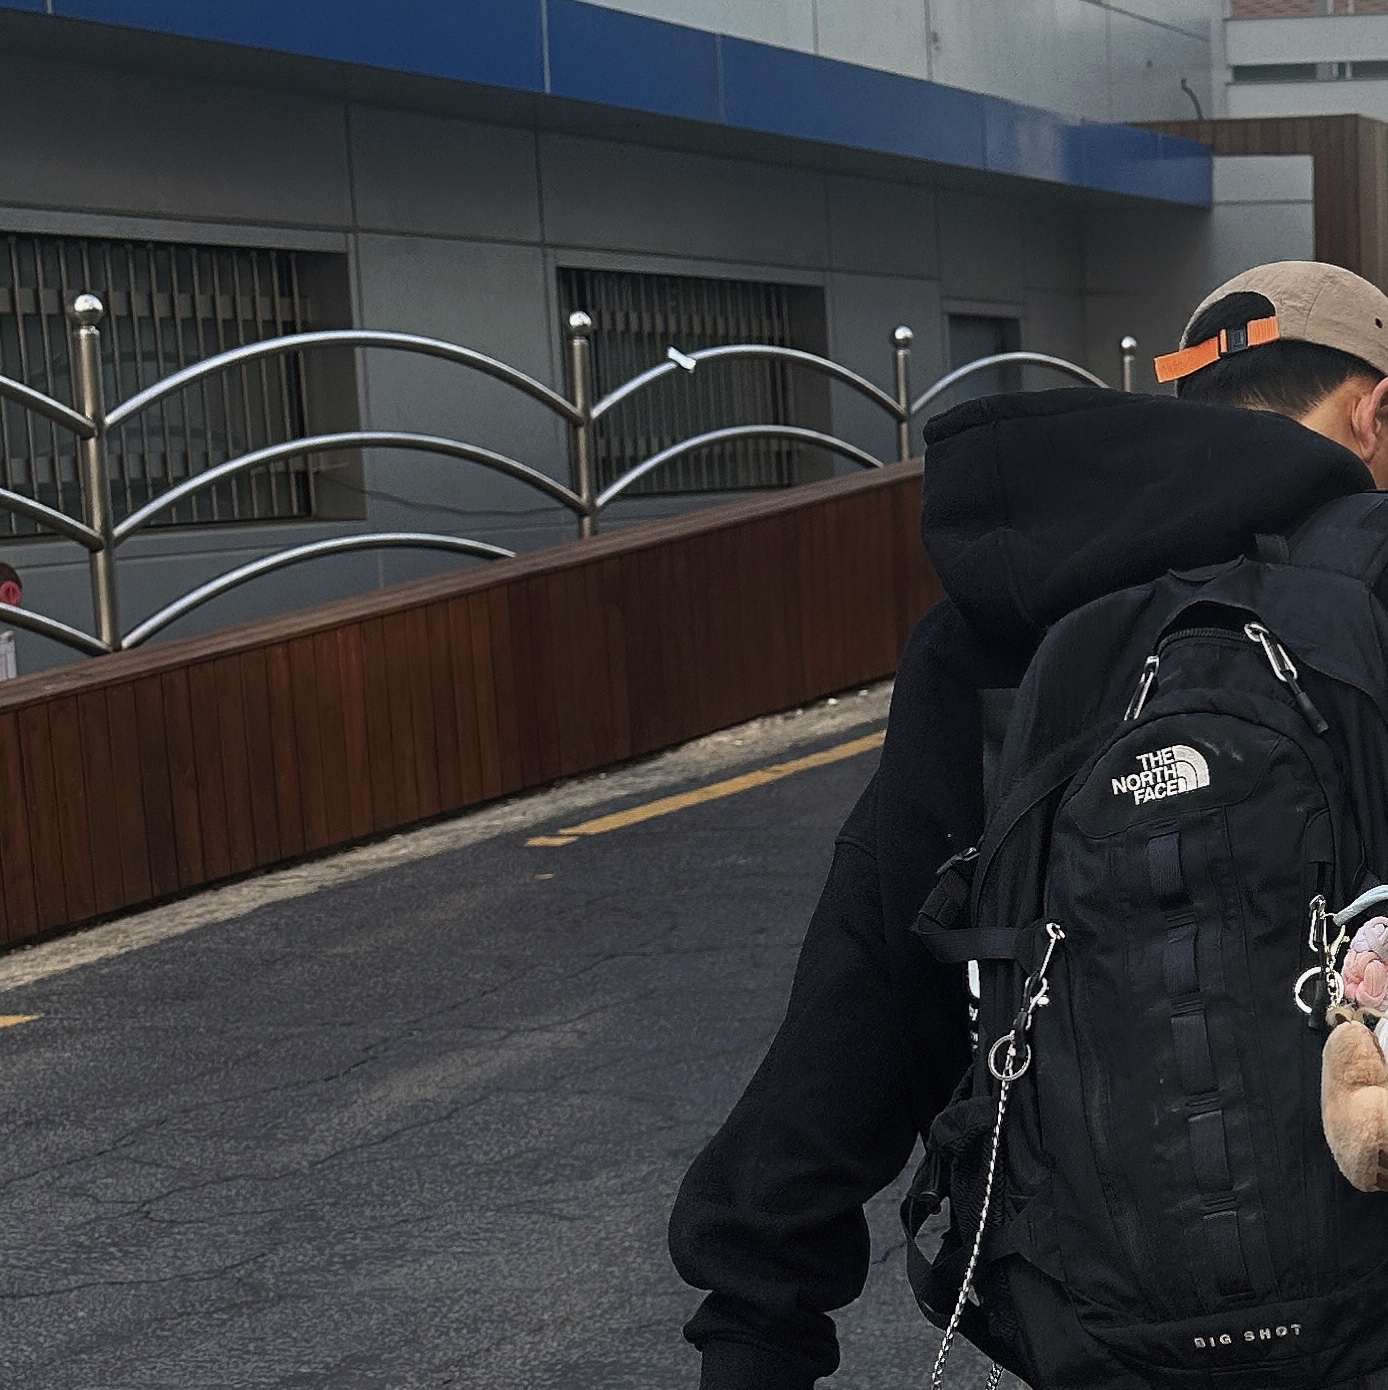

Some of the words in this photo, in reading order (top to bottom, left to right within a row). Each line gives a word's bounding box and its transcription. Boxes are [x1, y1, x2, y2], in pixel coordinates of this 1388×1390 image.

[1136, 746, 1176, 772] THE
[1111, 764, 1178, 795] NORTH
[1133, 777, 1179, 806] FACE
[1194, 1333, 1232, 1349] BIG
[1243, 1323, 1302, 1342] SHOT
